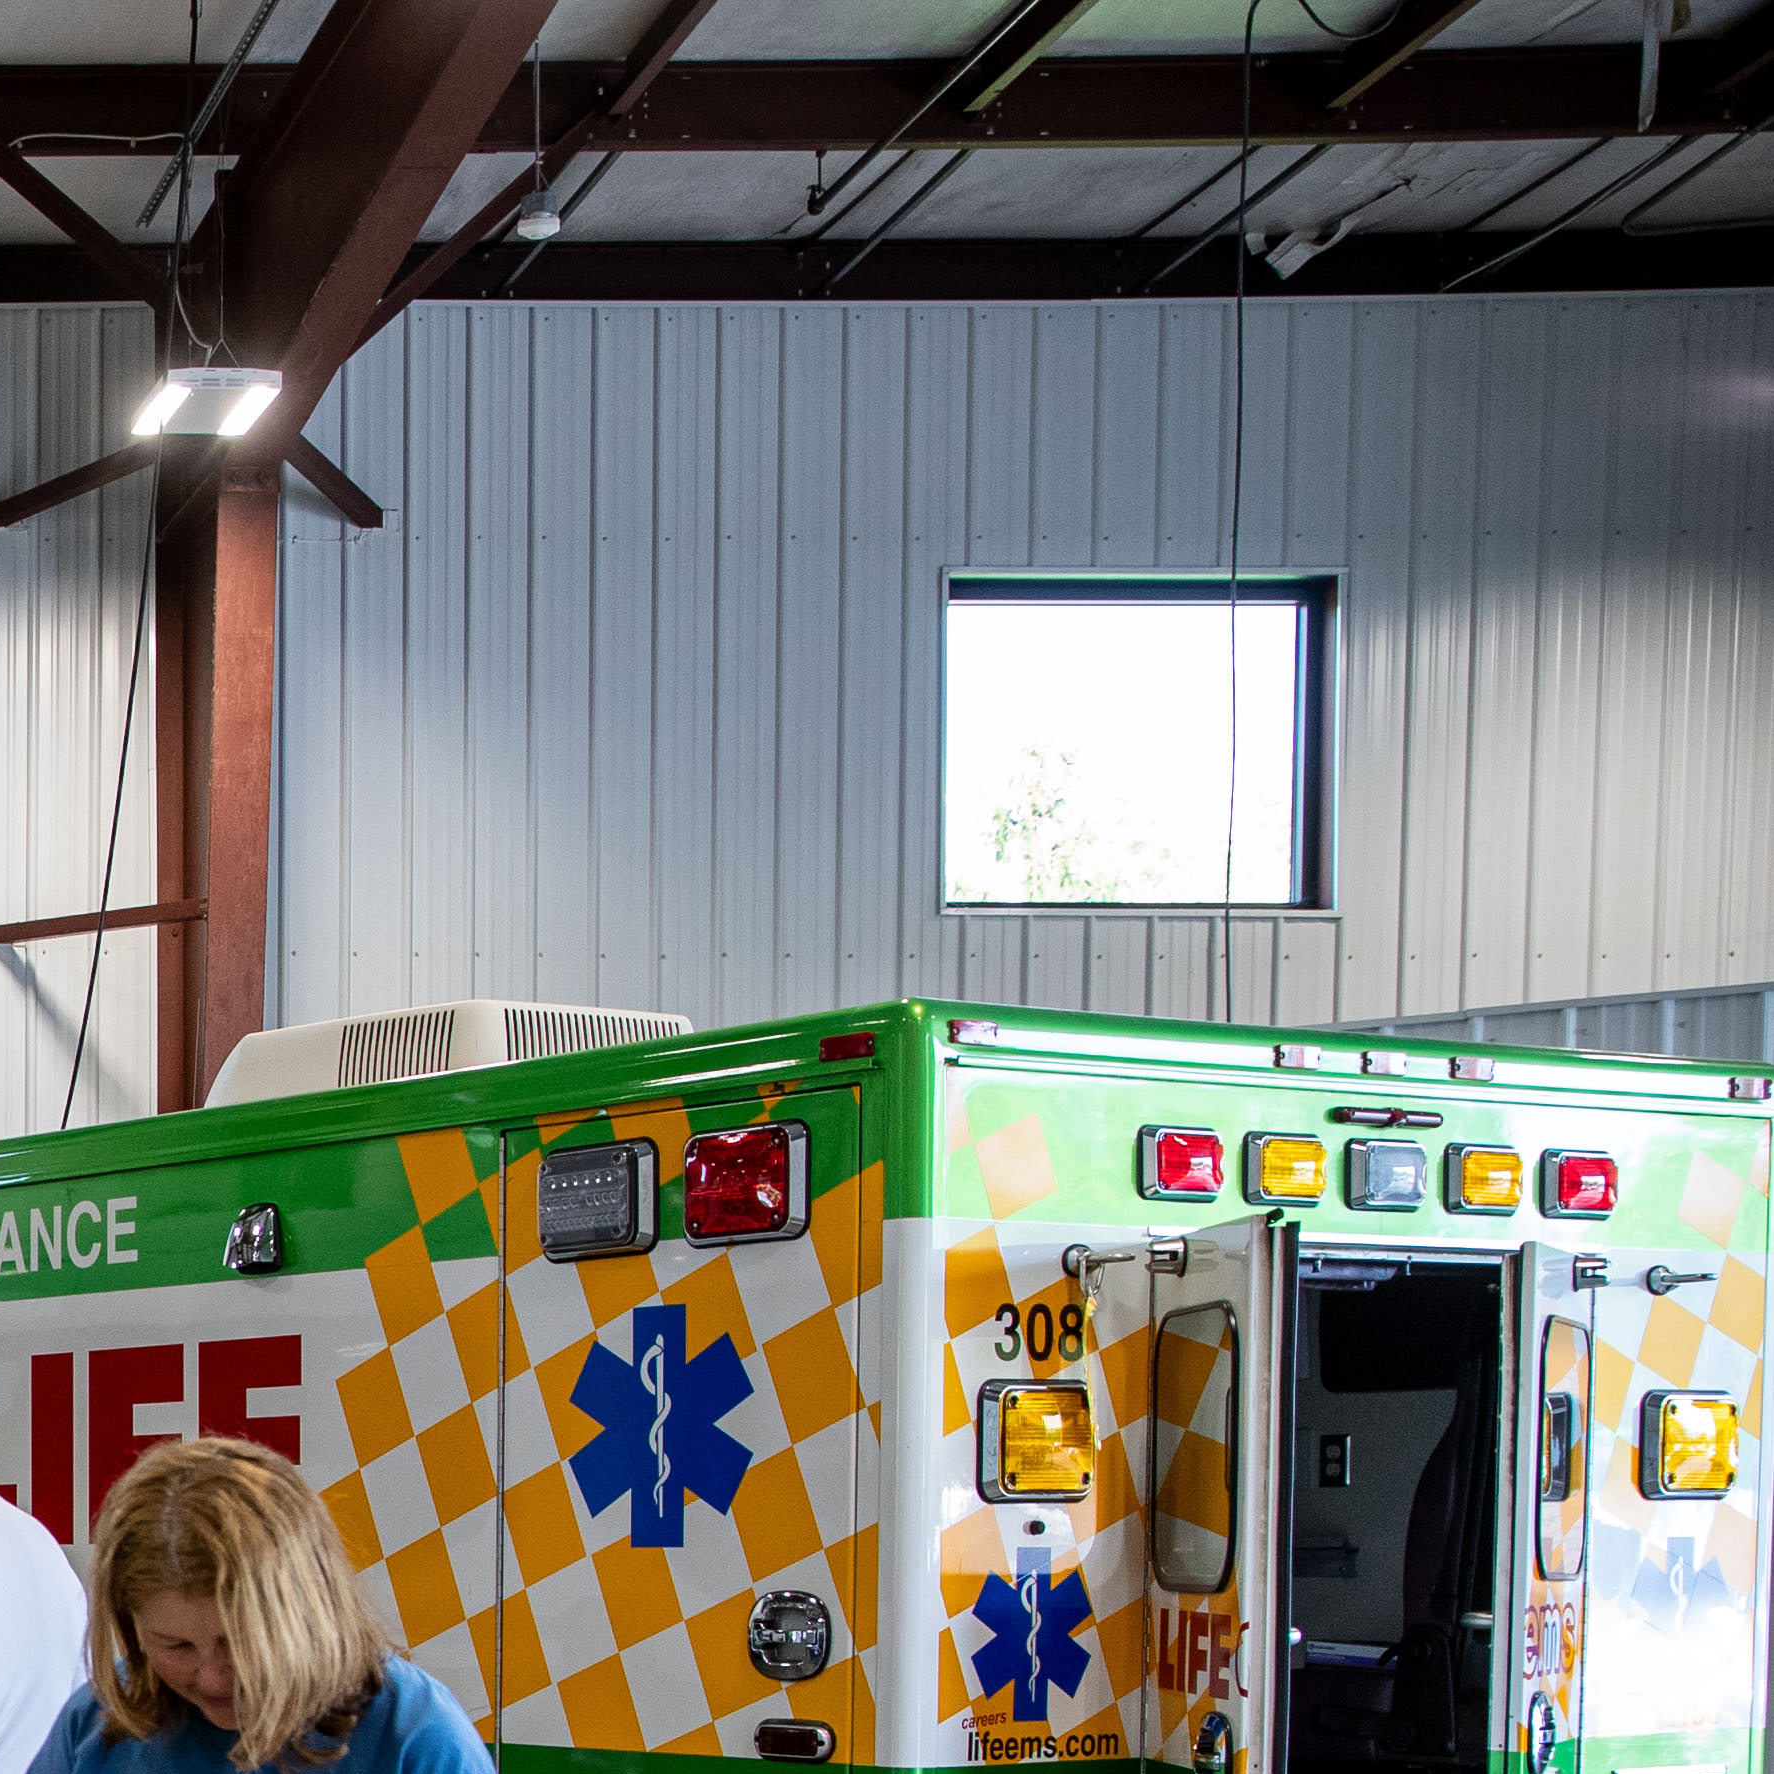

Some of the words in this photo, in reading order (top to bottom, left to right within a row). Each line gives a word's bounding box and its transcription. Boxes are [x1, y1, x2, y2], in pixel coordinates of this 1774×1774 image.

[994, 1303, 1084, 1362] 308
[1158, 1608, 1231, 1701] LIFE
[962, 1711, 1007, 1730] careers
[967, 1731, 1119, 1762] lifeems.com
